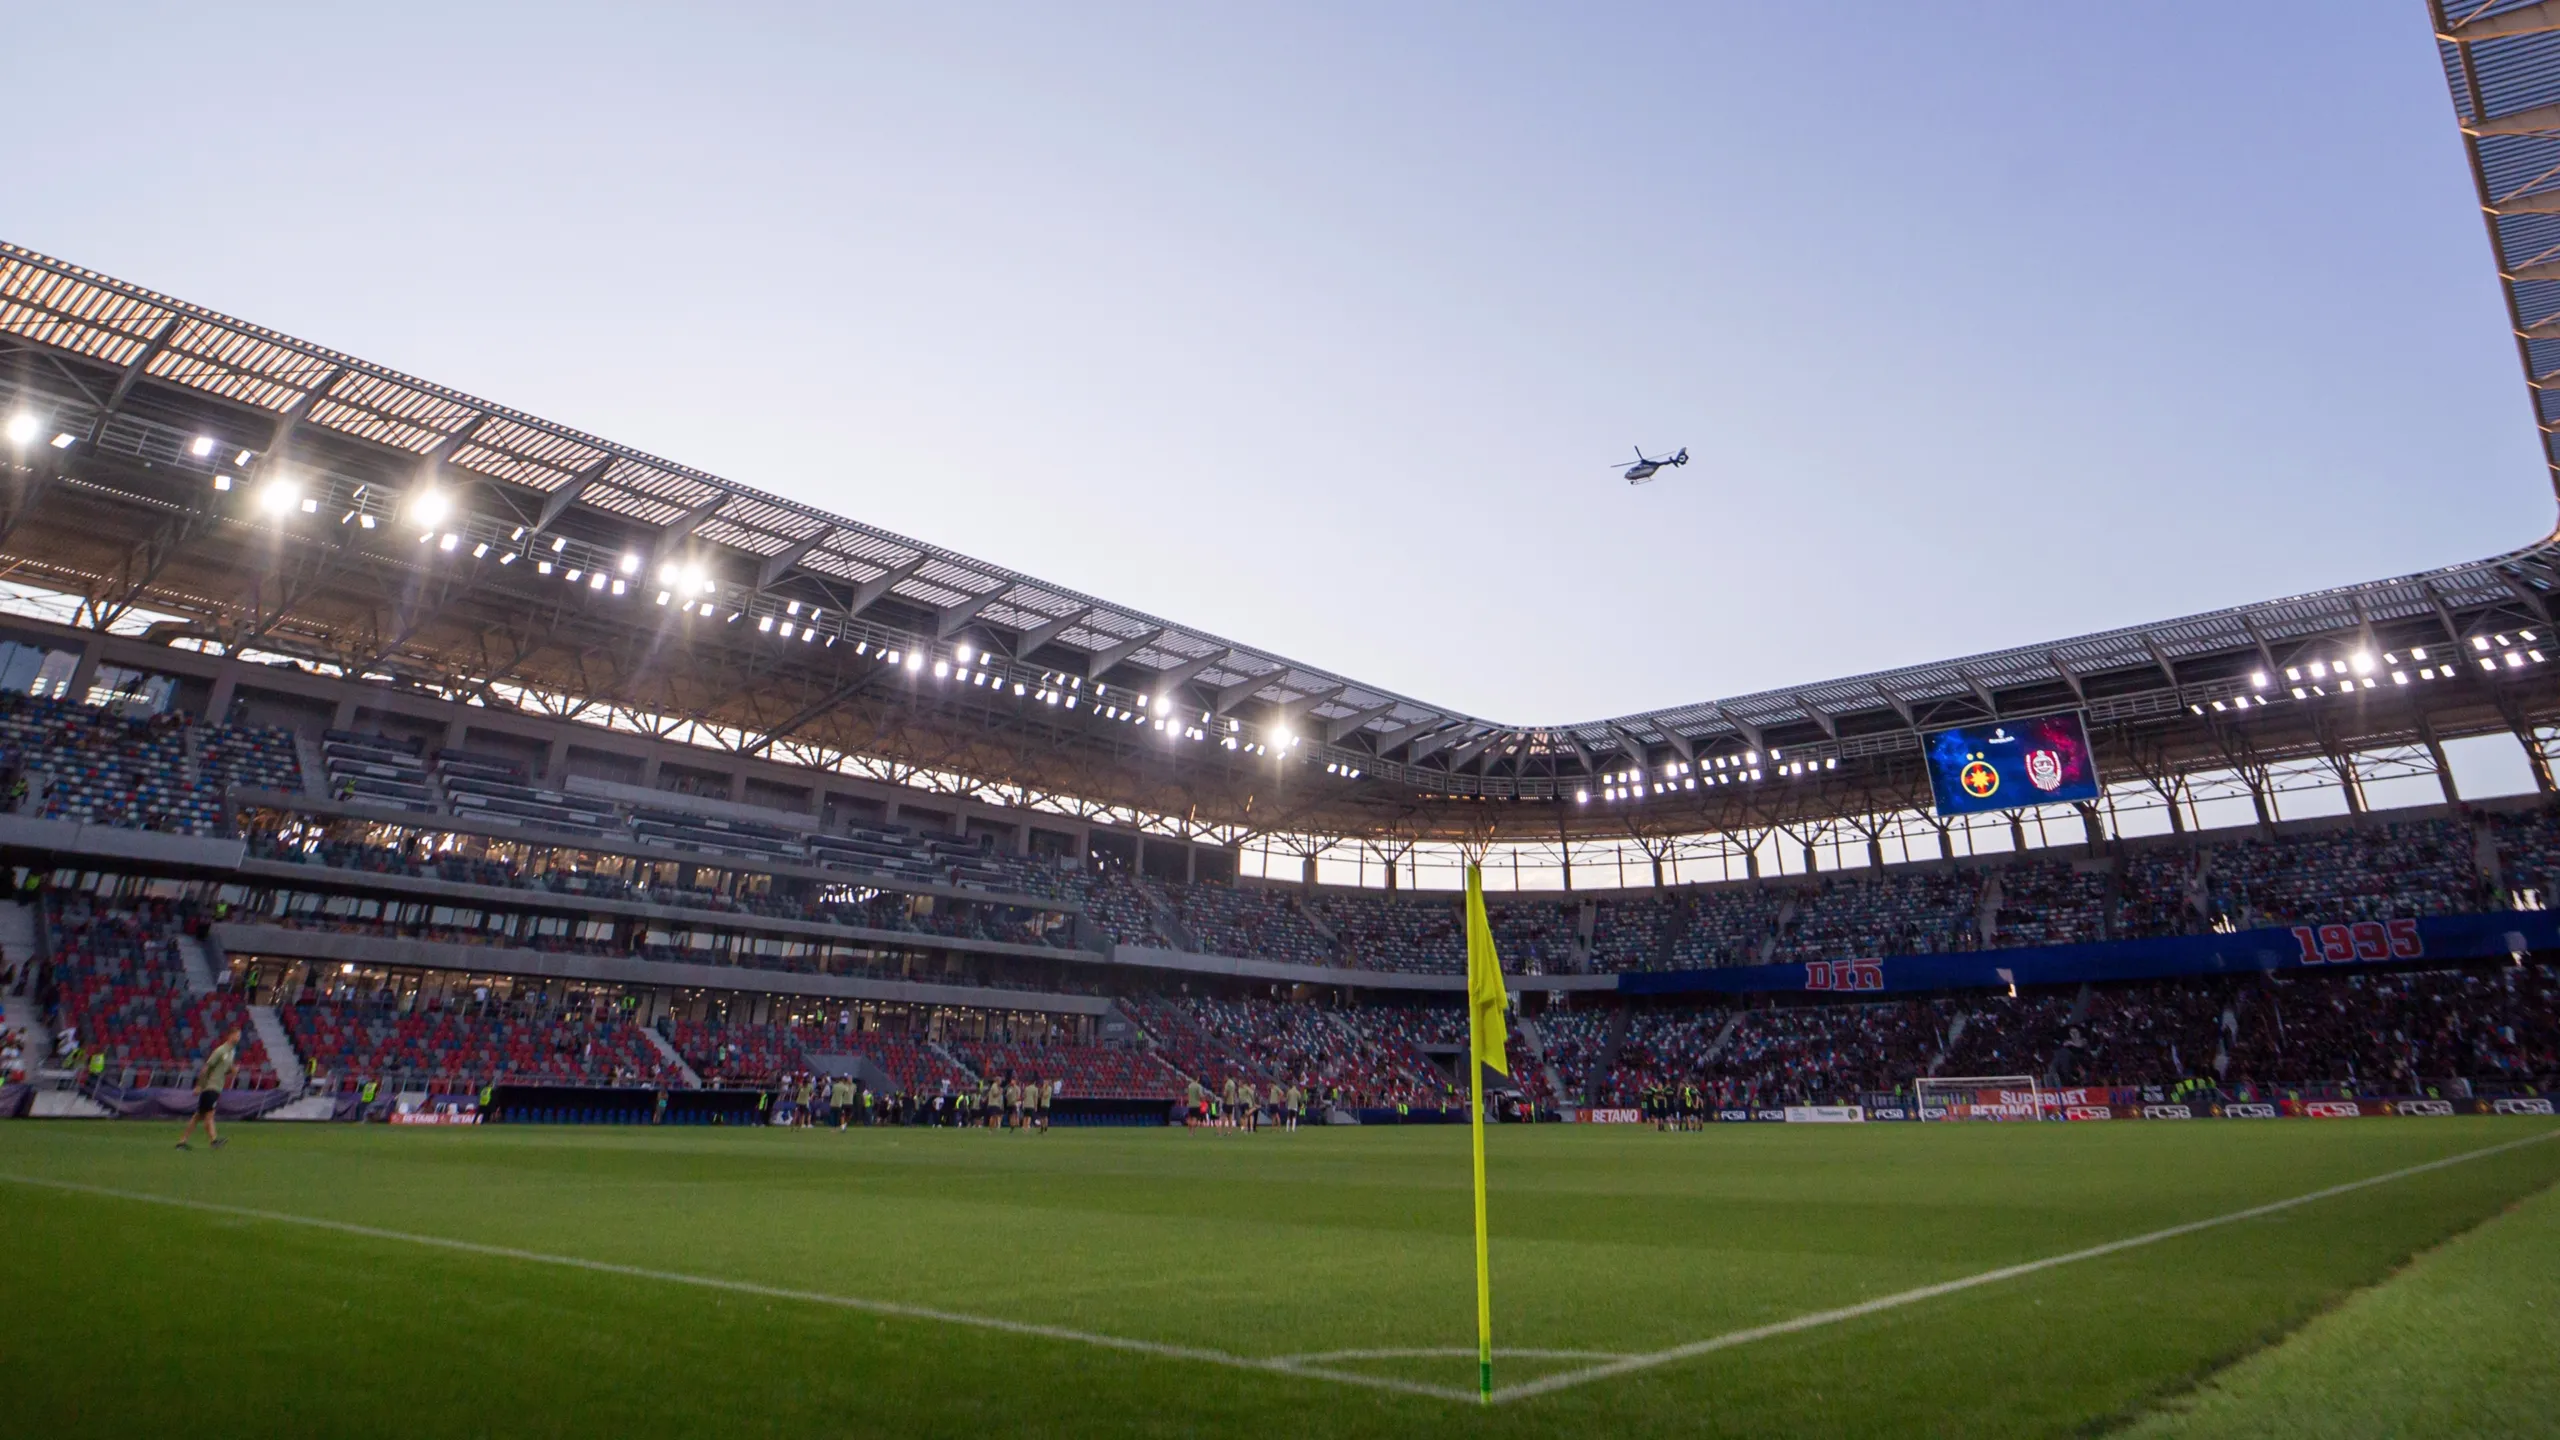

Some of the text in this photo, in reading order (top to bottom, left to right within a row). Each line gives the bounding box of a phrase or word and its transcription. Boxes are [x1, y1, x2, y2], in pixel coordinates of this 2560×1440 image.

[2291, 918, 2423, 964] 1995
[1875, 1108, 1904, 1119] FCSB
[2066, 1106, 2111, 1120] FCSB
[2143, 1104, 2192, 1119] FCSB
[2224, 1104, 2275, 1118] FCSB
[2305, 1102, 2360, 1117] FCSB
[2396, 1100, 2455, 1116] FCSB
[2493, 1099, 2555, 1115] FCSB
[1592, 1109, 1638, 1122] BETANO
[1721, 1110, 1746, 1120] FCSB
[1758, 1110, 1784, 1120] FCSB
